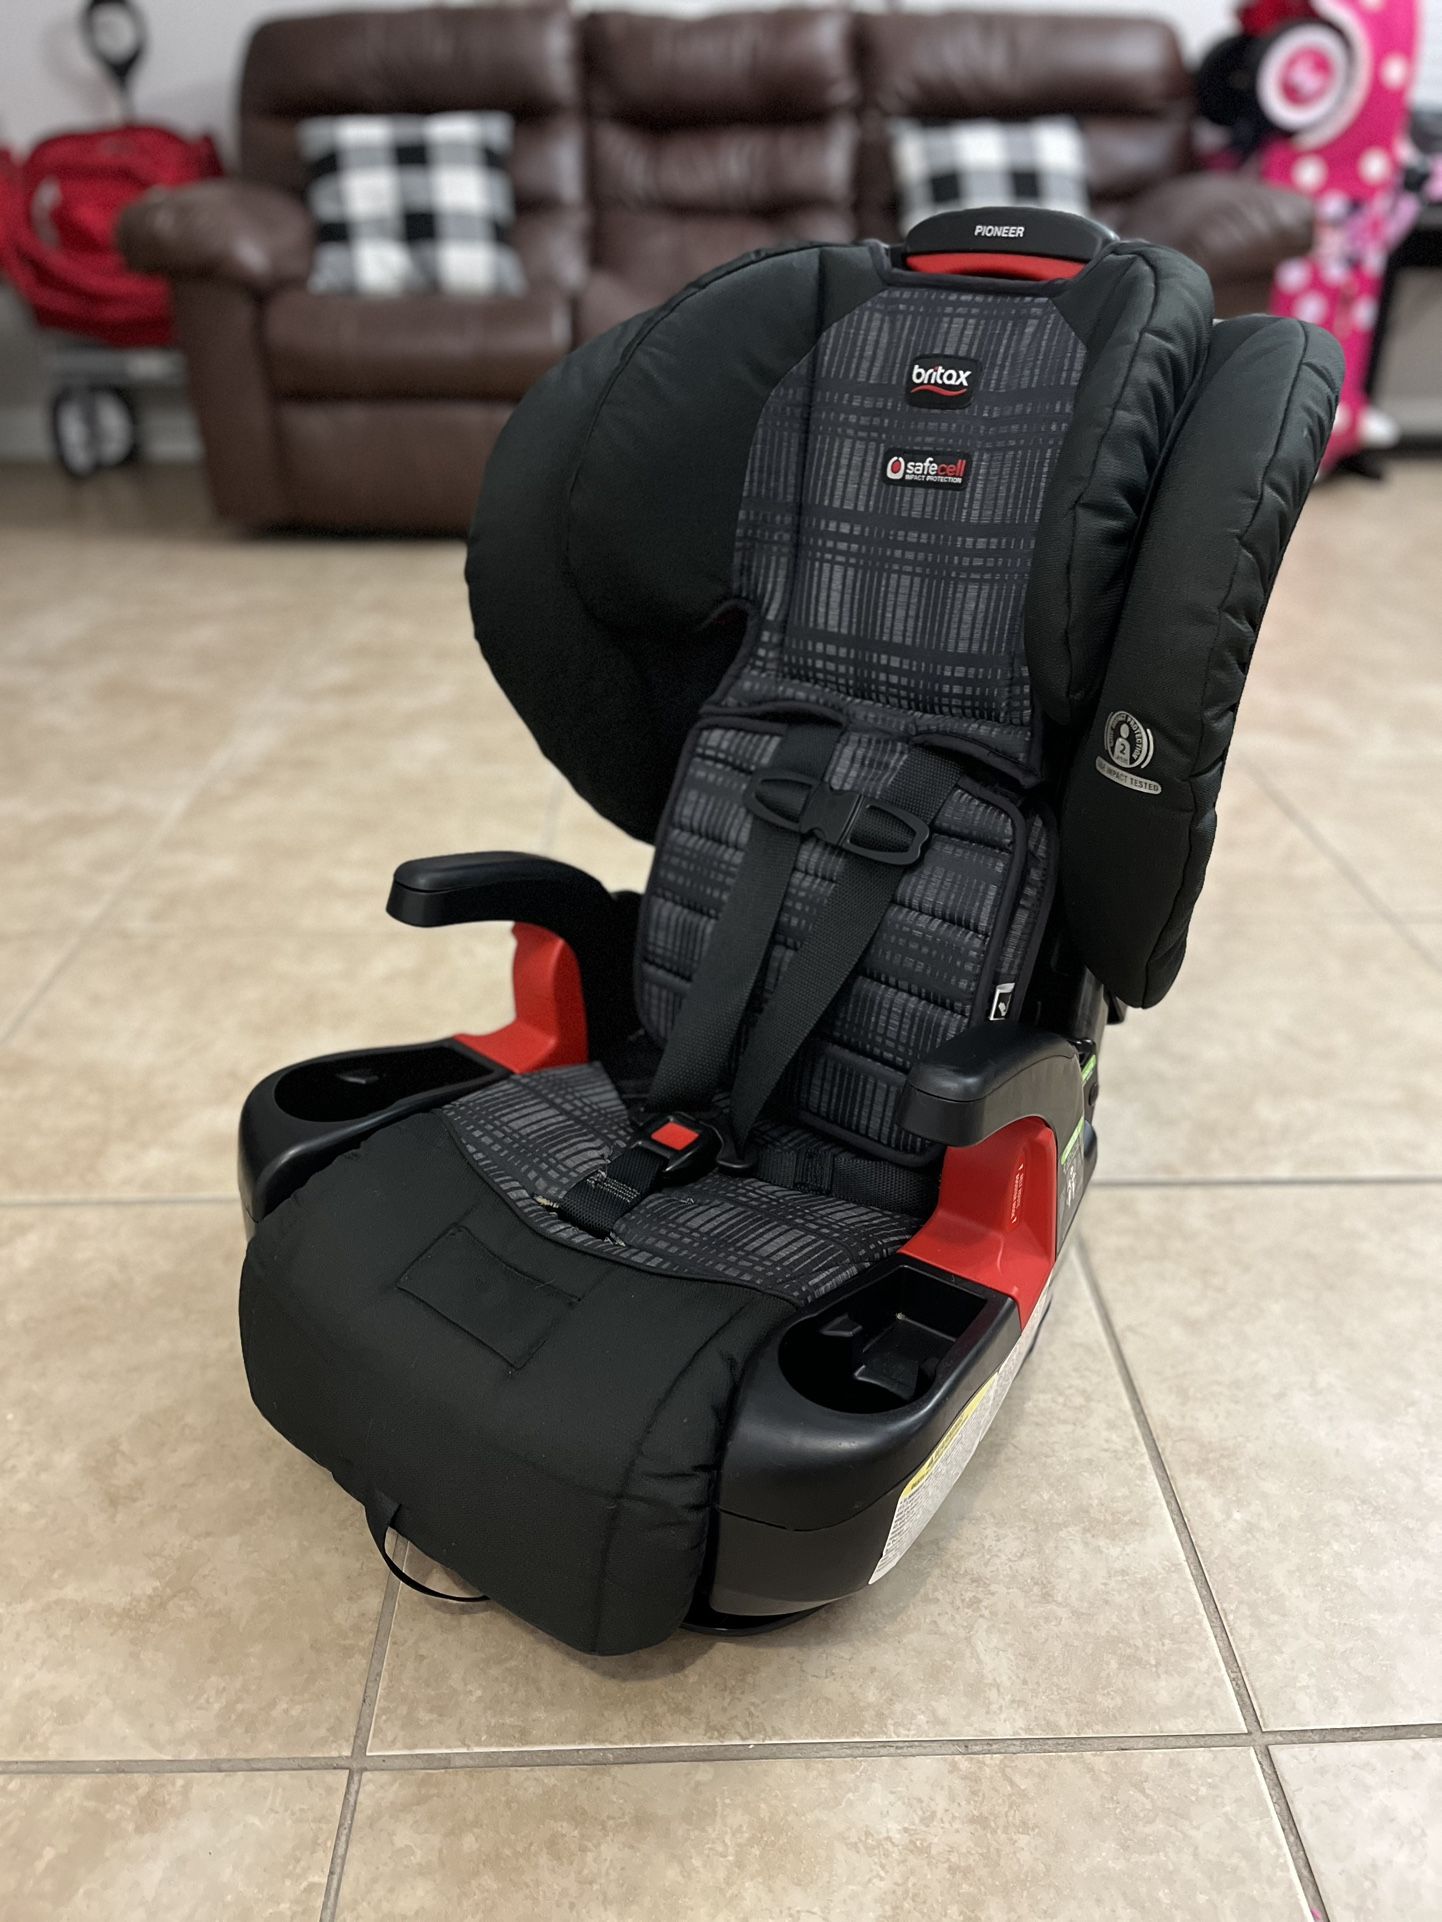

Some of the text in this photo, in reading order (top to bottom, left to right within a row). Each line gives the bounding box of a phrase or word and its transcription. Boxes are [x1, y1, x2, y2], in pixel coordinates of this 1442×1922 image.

[974, 225, 1025, 237] PIONEER
[912, 364, 972, 386] britax
[906, 457, 966, 477] safecell
[926, 475, 962, 484] PROTECTION
[1119, 743, 1126, 755] 2
[1130, 777, 1159, 792] TESTED
